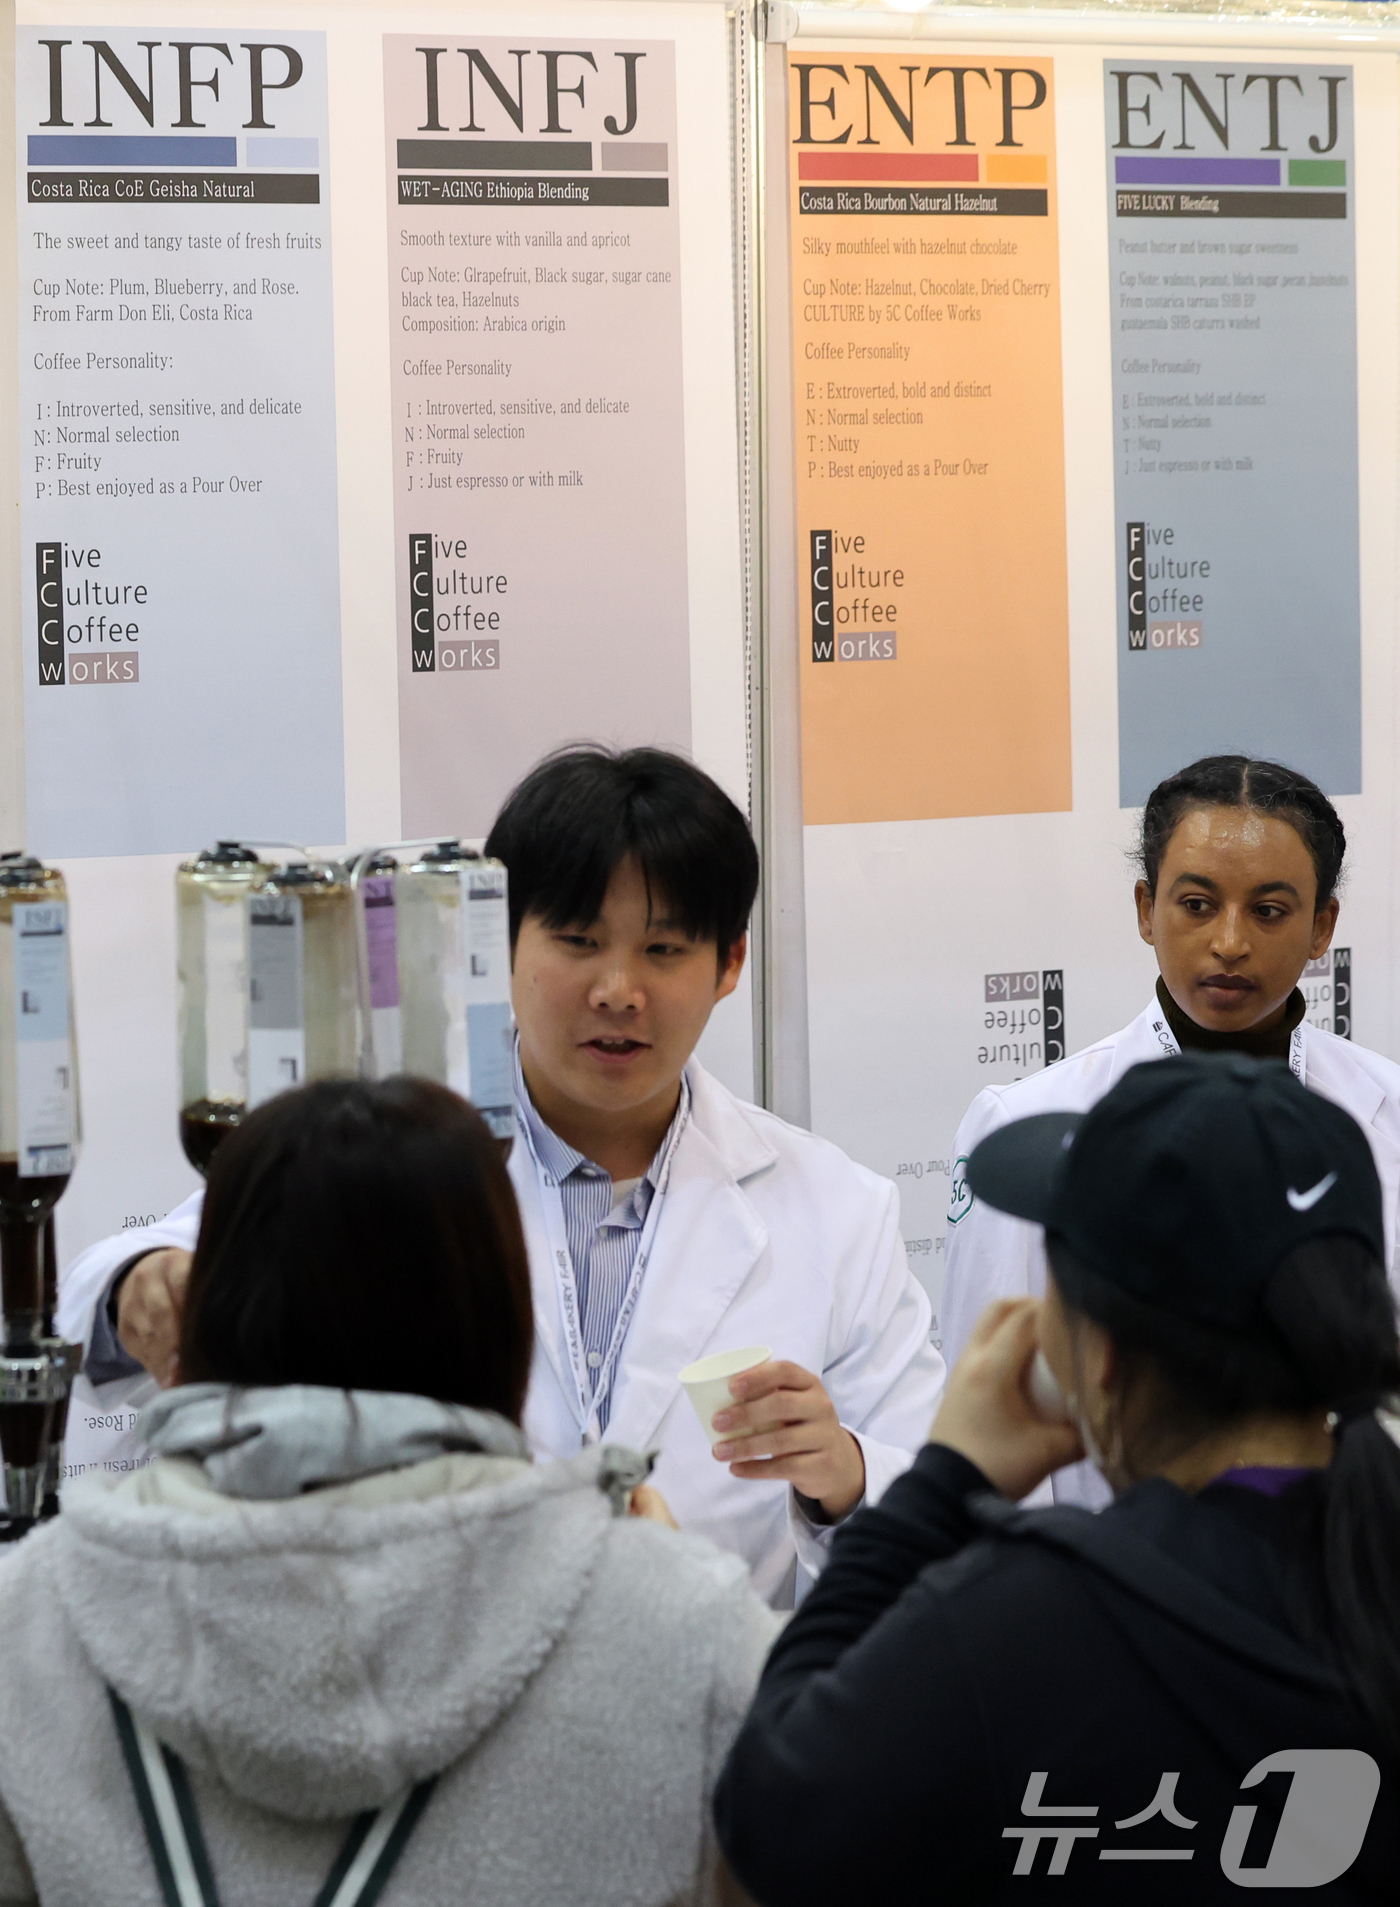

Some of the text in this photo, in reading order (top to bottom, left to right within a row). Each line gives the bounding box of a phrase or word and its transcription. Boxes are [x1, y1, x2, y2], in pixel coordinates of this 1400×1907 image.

[38, 40, 303, 130] INFP
[415, 48, 646, 136] INFJ
[790, 64, 1047, 148] ENTP
[1109, 71, 1347, 154] ENTJ
[31, 179, 254, 198] Costa Rica CoE Geisha Natural
[486, 181, 534, 201] Ethiopia
[537, 182, 589, 201] Blending
[798, 192, 998, 212] Costa Rica Bourbon Natural Hazelnut
[1116, 194, 1140, 212] FIVE
[1142, 194, 1175, 211] LUCKY
[32, 232, 322, 252] The sweet and tangy taste of fresh fruits
[400, 229, 630, 249] Smooth texture with vanilla and apricot
[802, 236, 1018, 257] Silky mouthfeel with hazelnut chocolate
[400, 266, 424, 285] Cup
[427, 266, 460, 283] Note:
[534, 267, 567, 283] Black
[571, 271, 608, 285] sugar,
[612, 271, 642, 286] sugar
[645, 271, 671, 283] cane
[33, 278, 298, 298] Cup Note: Plum, Blueberry, and Rose.
[802, 278, 826, 299] Cup
[981, 278, 1009, 296] Dried
[1012, 278, 1050, 298] Cherry
[401, 291, 519, 309] black tea, Hazelnuts
[32, 303, 252, 322] From Farm Don Eli, Costa Rica
[803, 304, 981, 324] CULTURE by 5C Coffee Works
[402, 315, 566, 334] Composition: Arabica origin
[33, 352, 172, 371] Coffee Personality:
[804, 342, 910, 361] Coffee Personality
[402, 359, 512, 377] Coffee Personality
[901, 381, 926, 399] bold
[930, 380, 950, 398] and
[953, 380, 992, 398] distinct
[56, 397, 301, 417] Introverted, sensitive, and delicate
[426, 397, 629, 416] Introverted, sensitive, and delicate
[826, 408, 923, 426] Normal selection
[56, 425, 179, 444] Normal selection
[426, 423, 524, 440] Normal selection
[827, 434, 860, 454] Nutty
[56, 452, 101, 472] Fruity
[427, 448, 463, 466] Fruity
[828, 458, 988, 480] Best enjoyed as Pour Over
[58, 475, 262, 497] Best enjoyed as Pour Over
[427, 470, 583, 490] Just espresso or with milk
[895, 1161, 923, 1179] Over
[84, 1415, 124, 1431] Rose.
